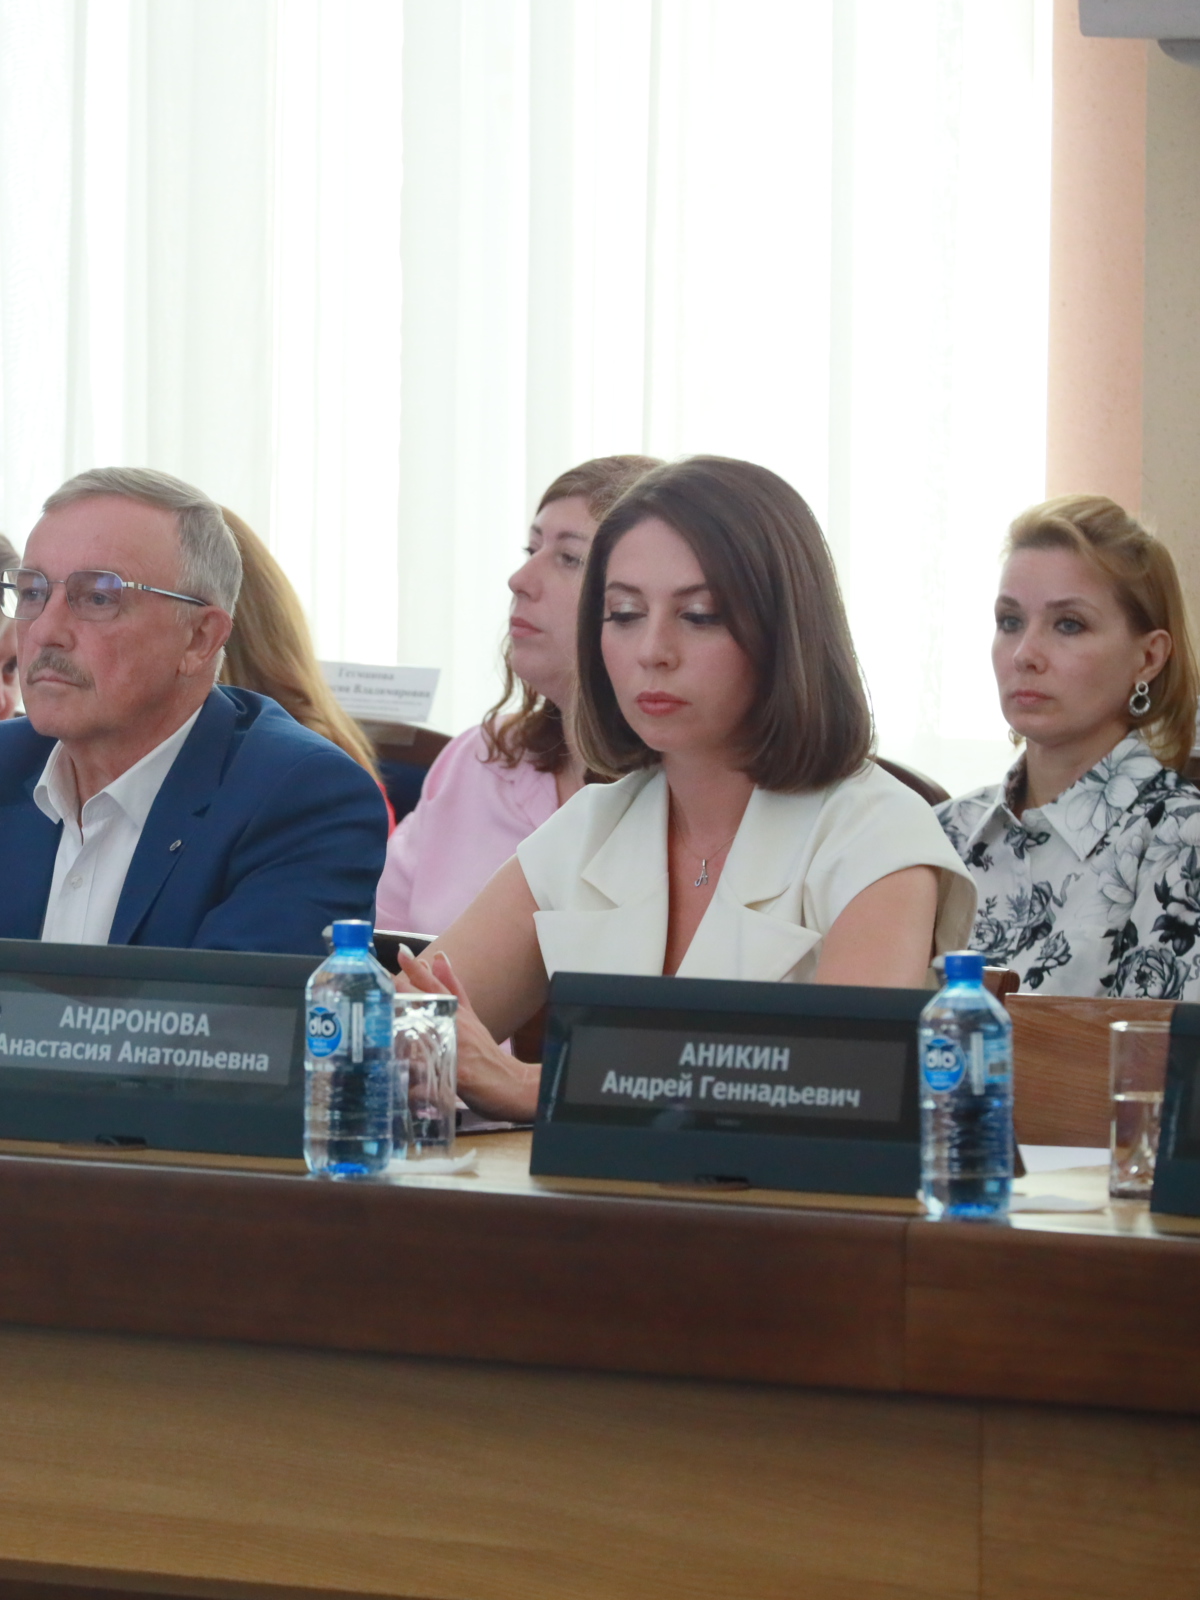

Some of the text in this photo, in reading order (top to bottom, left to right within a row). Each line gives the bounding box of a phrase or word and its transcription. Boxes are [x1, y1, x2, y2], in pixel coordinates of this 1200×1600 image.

[59, 1005, 211, 1037] АНДРОНОВА
[309, 1016, 335, 1035] dio
[118, 1040, 269, 1072] Анатольевна
[679, 1042, 790, 1071] АНИКИН
[601, 1070, 861, 1108] Андрей Геннадьевич
